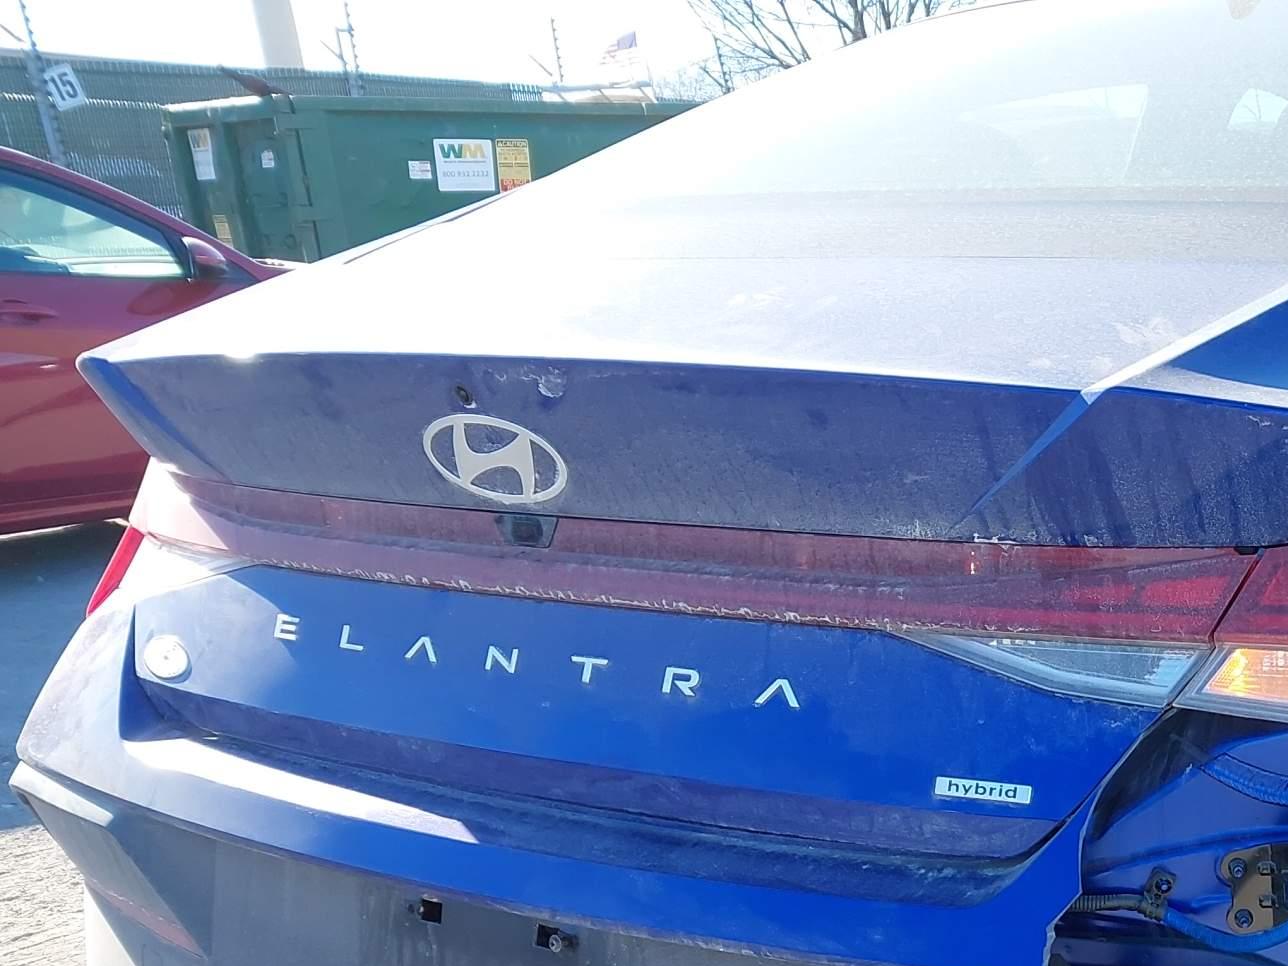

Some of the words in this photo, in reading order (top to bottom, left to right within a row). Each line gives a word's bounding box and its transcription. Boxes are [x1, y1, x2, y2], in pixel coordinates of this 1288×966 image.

[49, 72, 78, 101] 15
[439, 143, 486, 159] WM
[273, 613, 800, 708] ELANTRA
[947, 780, 1017, 799] hybrid
